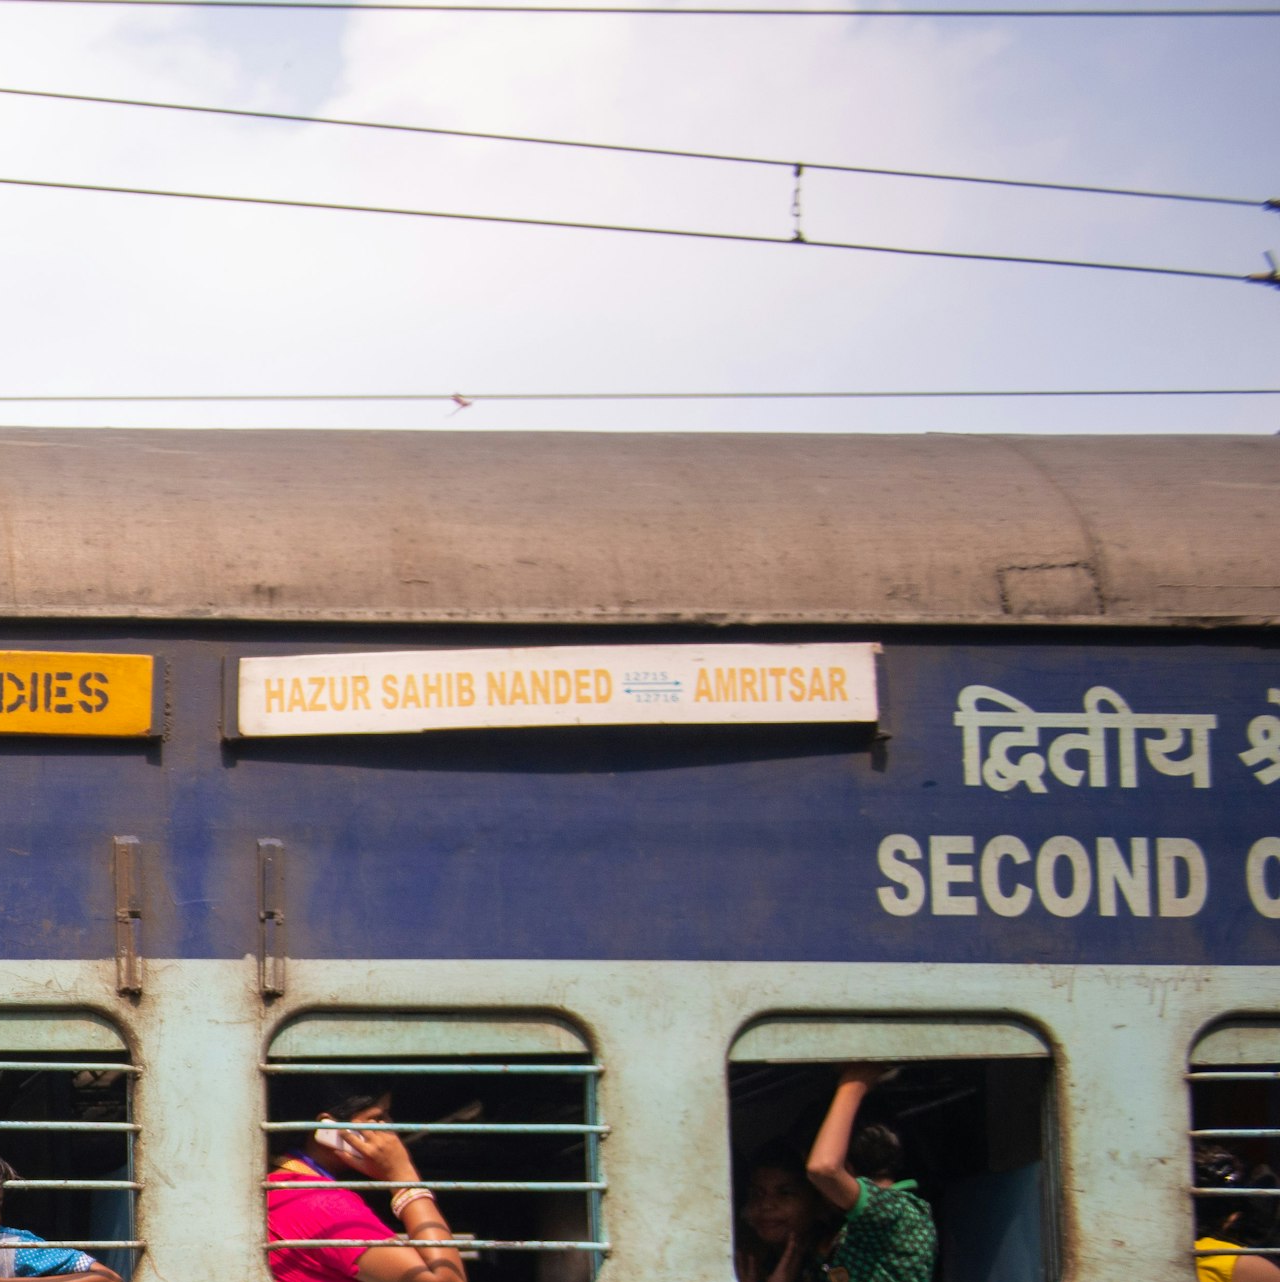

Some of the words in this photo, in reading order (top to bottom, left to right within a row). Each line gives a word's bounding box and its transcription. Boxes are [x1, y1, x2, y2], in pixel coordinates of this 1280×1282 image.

[264, 675, 372, 713] HAZUR
[381, 671, 476, 709] SAHIB
[486, 668, 614, 706] NANDED
[694, 666, 849, 702] AMRITSAR
[624, 671, 669, 681] 12715
[635, 693, 681, 703] 12716
[953, 684, 1218, 794] द्वितीय
[876, 833, 1209, 918] SECOND
